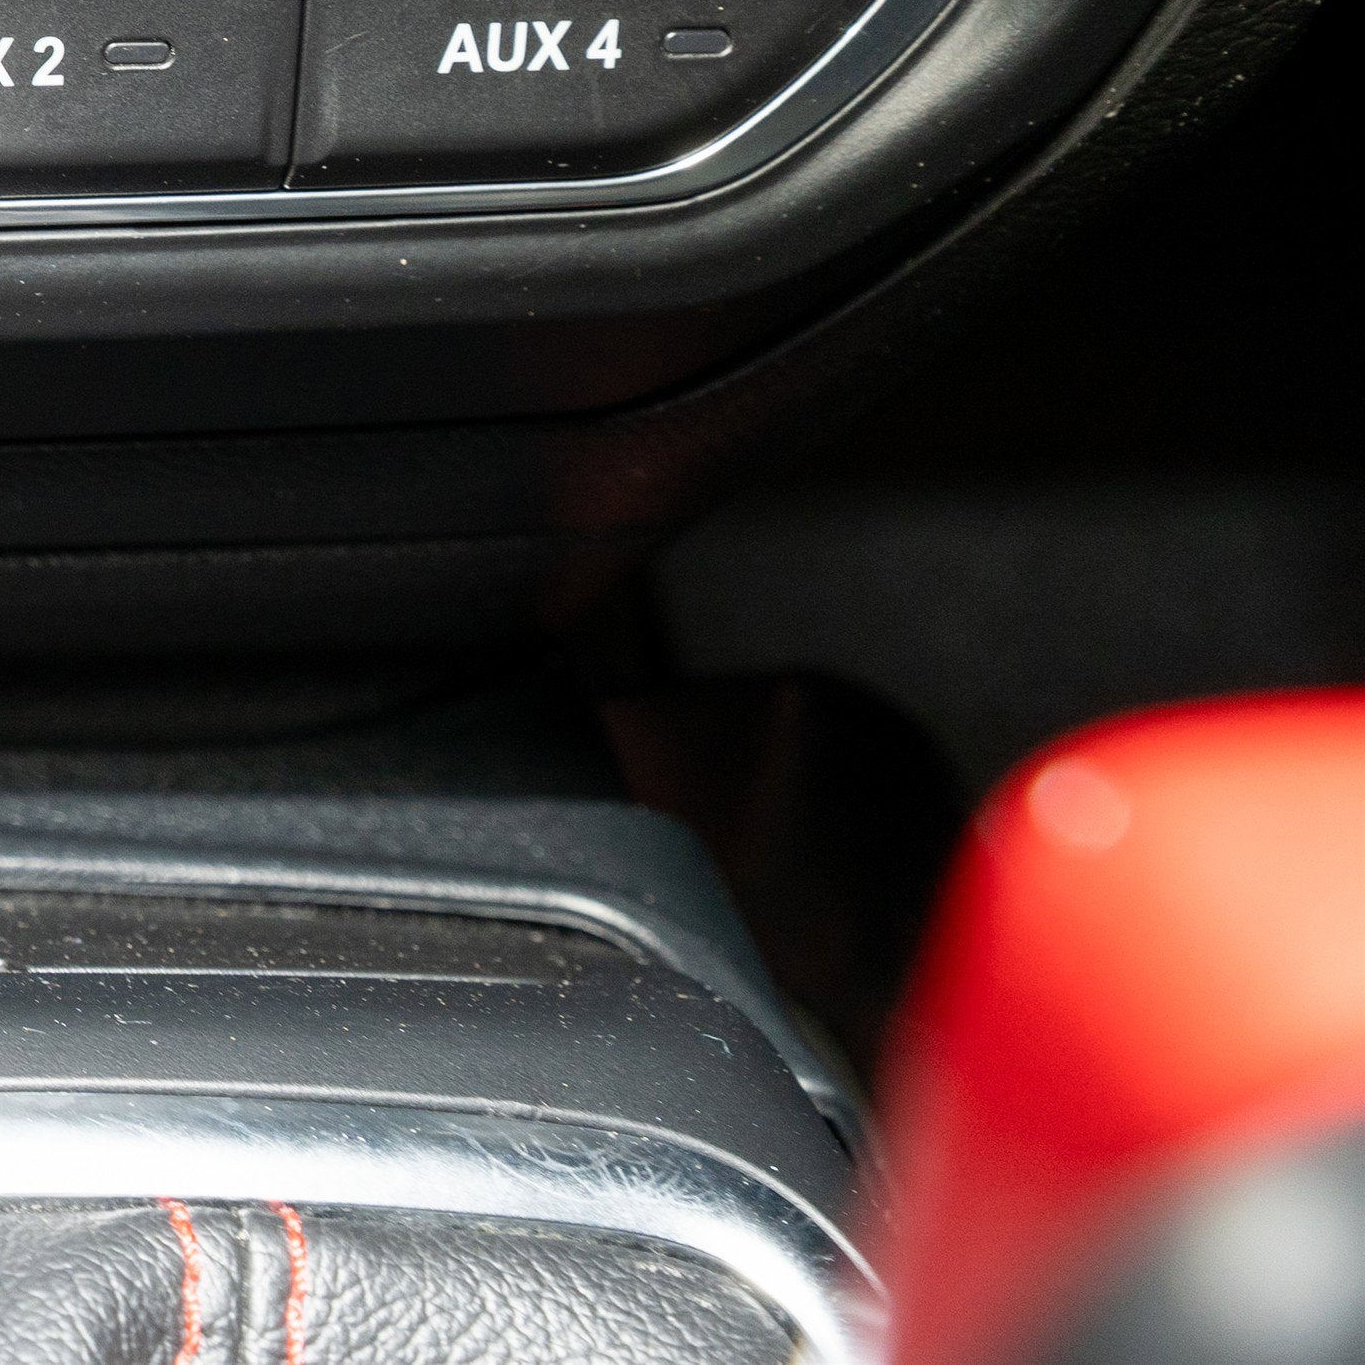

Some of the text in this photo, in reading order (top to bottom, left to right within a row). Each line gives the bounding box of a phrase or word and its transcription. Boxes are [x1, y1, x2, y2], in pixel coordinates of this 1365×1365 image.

[32, 36, 66, 87] 2
[437, 18, 622, 74] AUX 4
